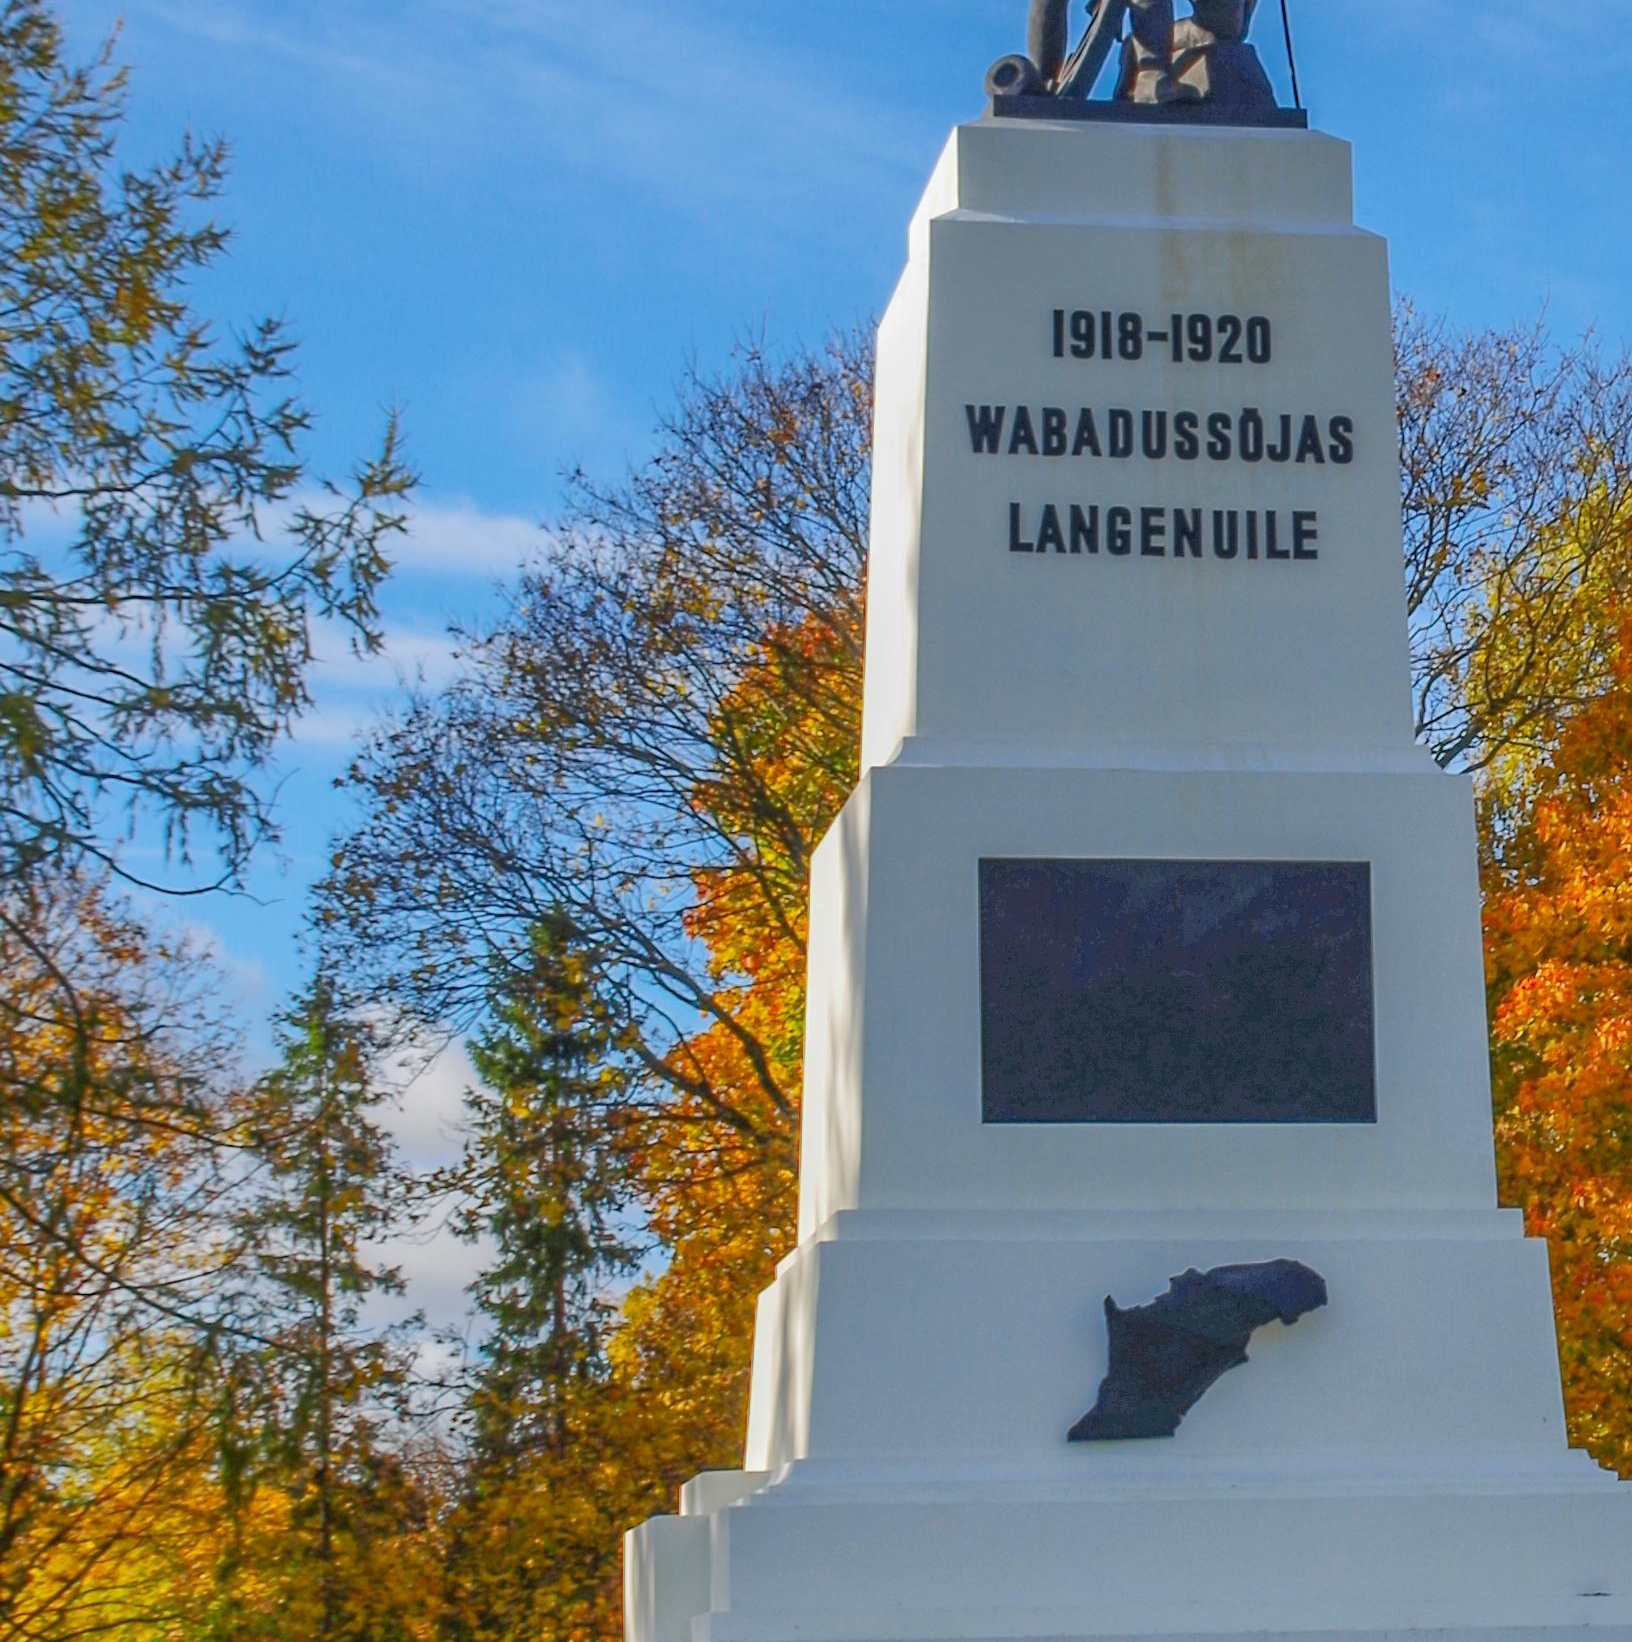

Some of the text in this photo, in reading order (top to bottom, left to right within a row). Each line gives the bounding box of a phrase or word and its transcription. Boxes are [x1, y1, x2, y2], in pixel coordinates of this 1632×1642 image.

[1052, 309, 1272, 365] 1918-1920
[964, 404, 1354, 465] WABADUSSÕJAS
[1009, 502, 1318, 560] LANGENUILE
